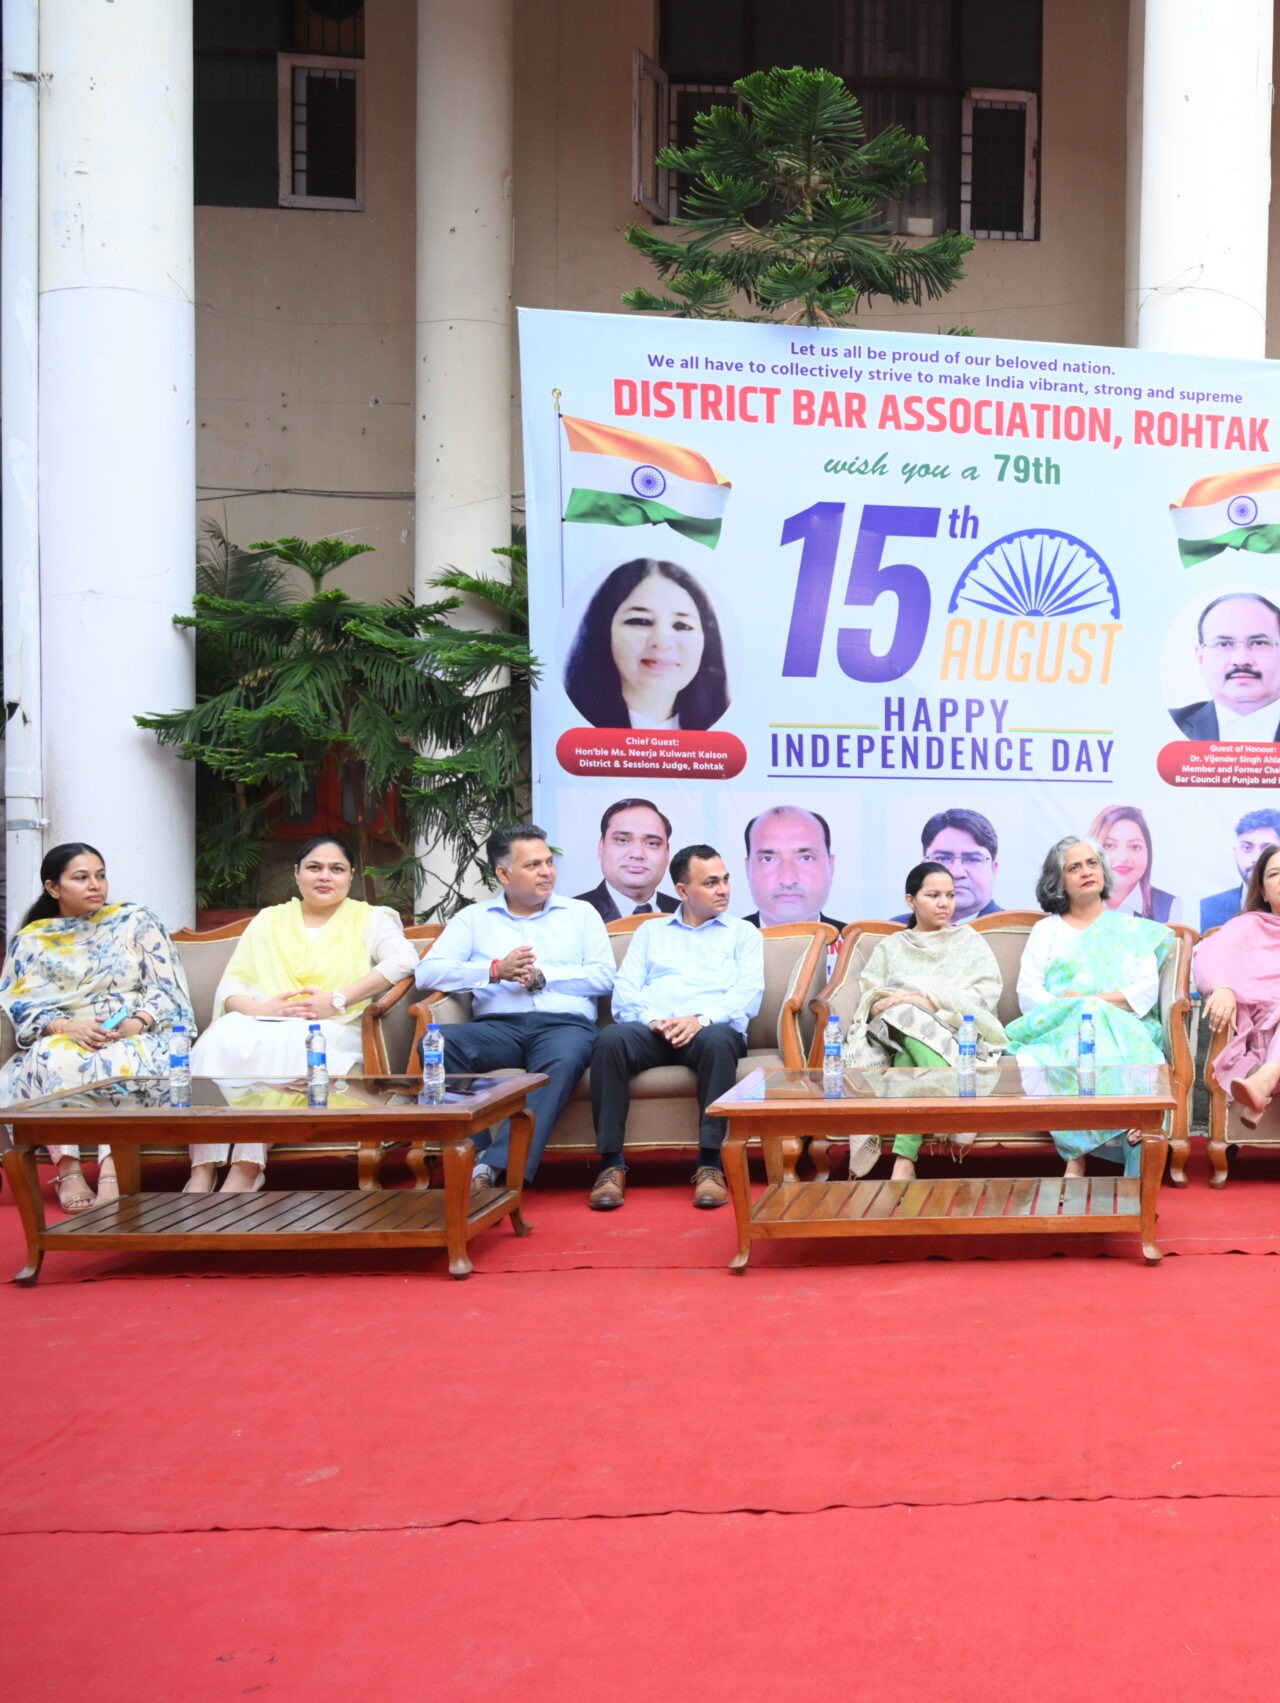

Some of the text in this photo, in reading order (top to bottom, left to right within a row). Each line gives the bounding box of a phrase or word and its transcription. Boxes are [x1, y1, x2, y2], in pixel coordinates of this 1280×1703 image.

[790, 342, 1116, 376] Let us all be proud of our beloved nation.
[647, 354, 1243, 405] We all have to collectively strive to make India vibrant, strong and supreme
[613, 378, 1270, 453] DISTRICT BAR ASSOCIATION, ROHTAK
[823, 452, 1062, 485] wish you a 79th
[940, 617, 1123, 685] AUGUST
[883, 696, 1010, 734] HAPPY
[625, 736, 680, 747] Chief Guest:
[771, 733, 1115, 773] INDEPENDENCE DAY
[1209, 744, 1277, 754] Guest of Honour:
[579, 759, 724, 772] District & Sessions Judge, Rohtak
[611, 748, 627, 757] Ms.
[628, 749, 658, 760] Neerja
[659, 749, 696, 759] Kulwant
[698, 751, 728, 760] Kalson
[1189, 754, 1203, 763] Dr.
[1203, 755, 1238, 765] Vijender
[1239, 755, 1262, 765] Singh
[1175, 775, 1189, 783] Bar
[1190, 775, 1221, 784] Council
[1221, 776, 1231, 784] of
[1232, 776, 1259, 786] Punjab
[1261, 776, 1277, 784] and
[1181, 765, 1215, 774] Member
[1217, 766, 1233, 774] and
[1234, 766, 1263, 774] Former
